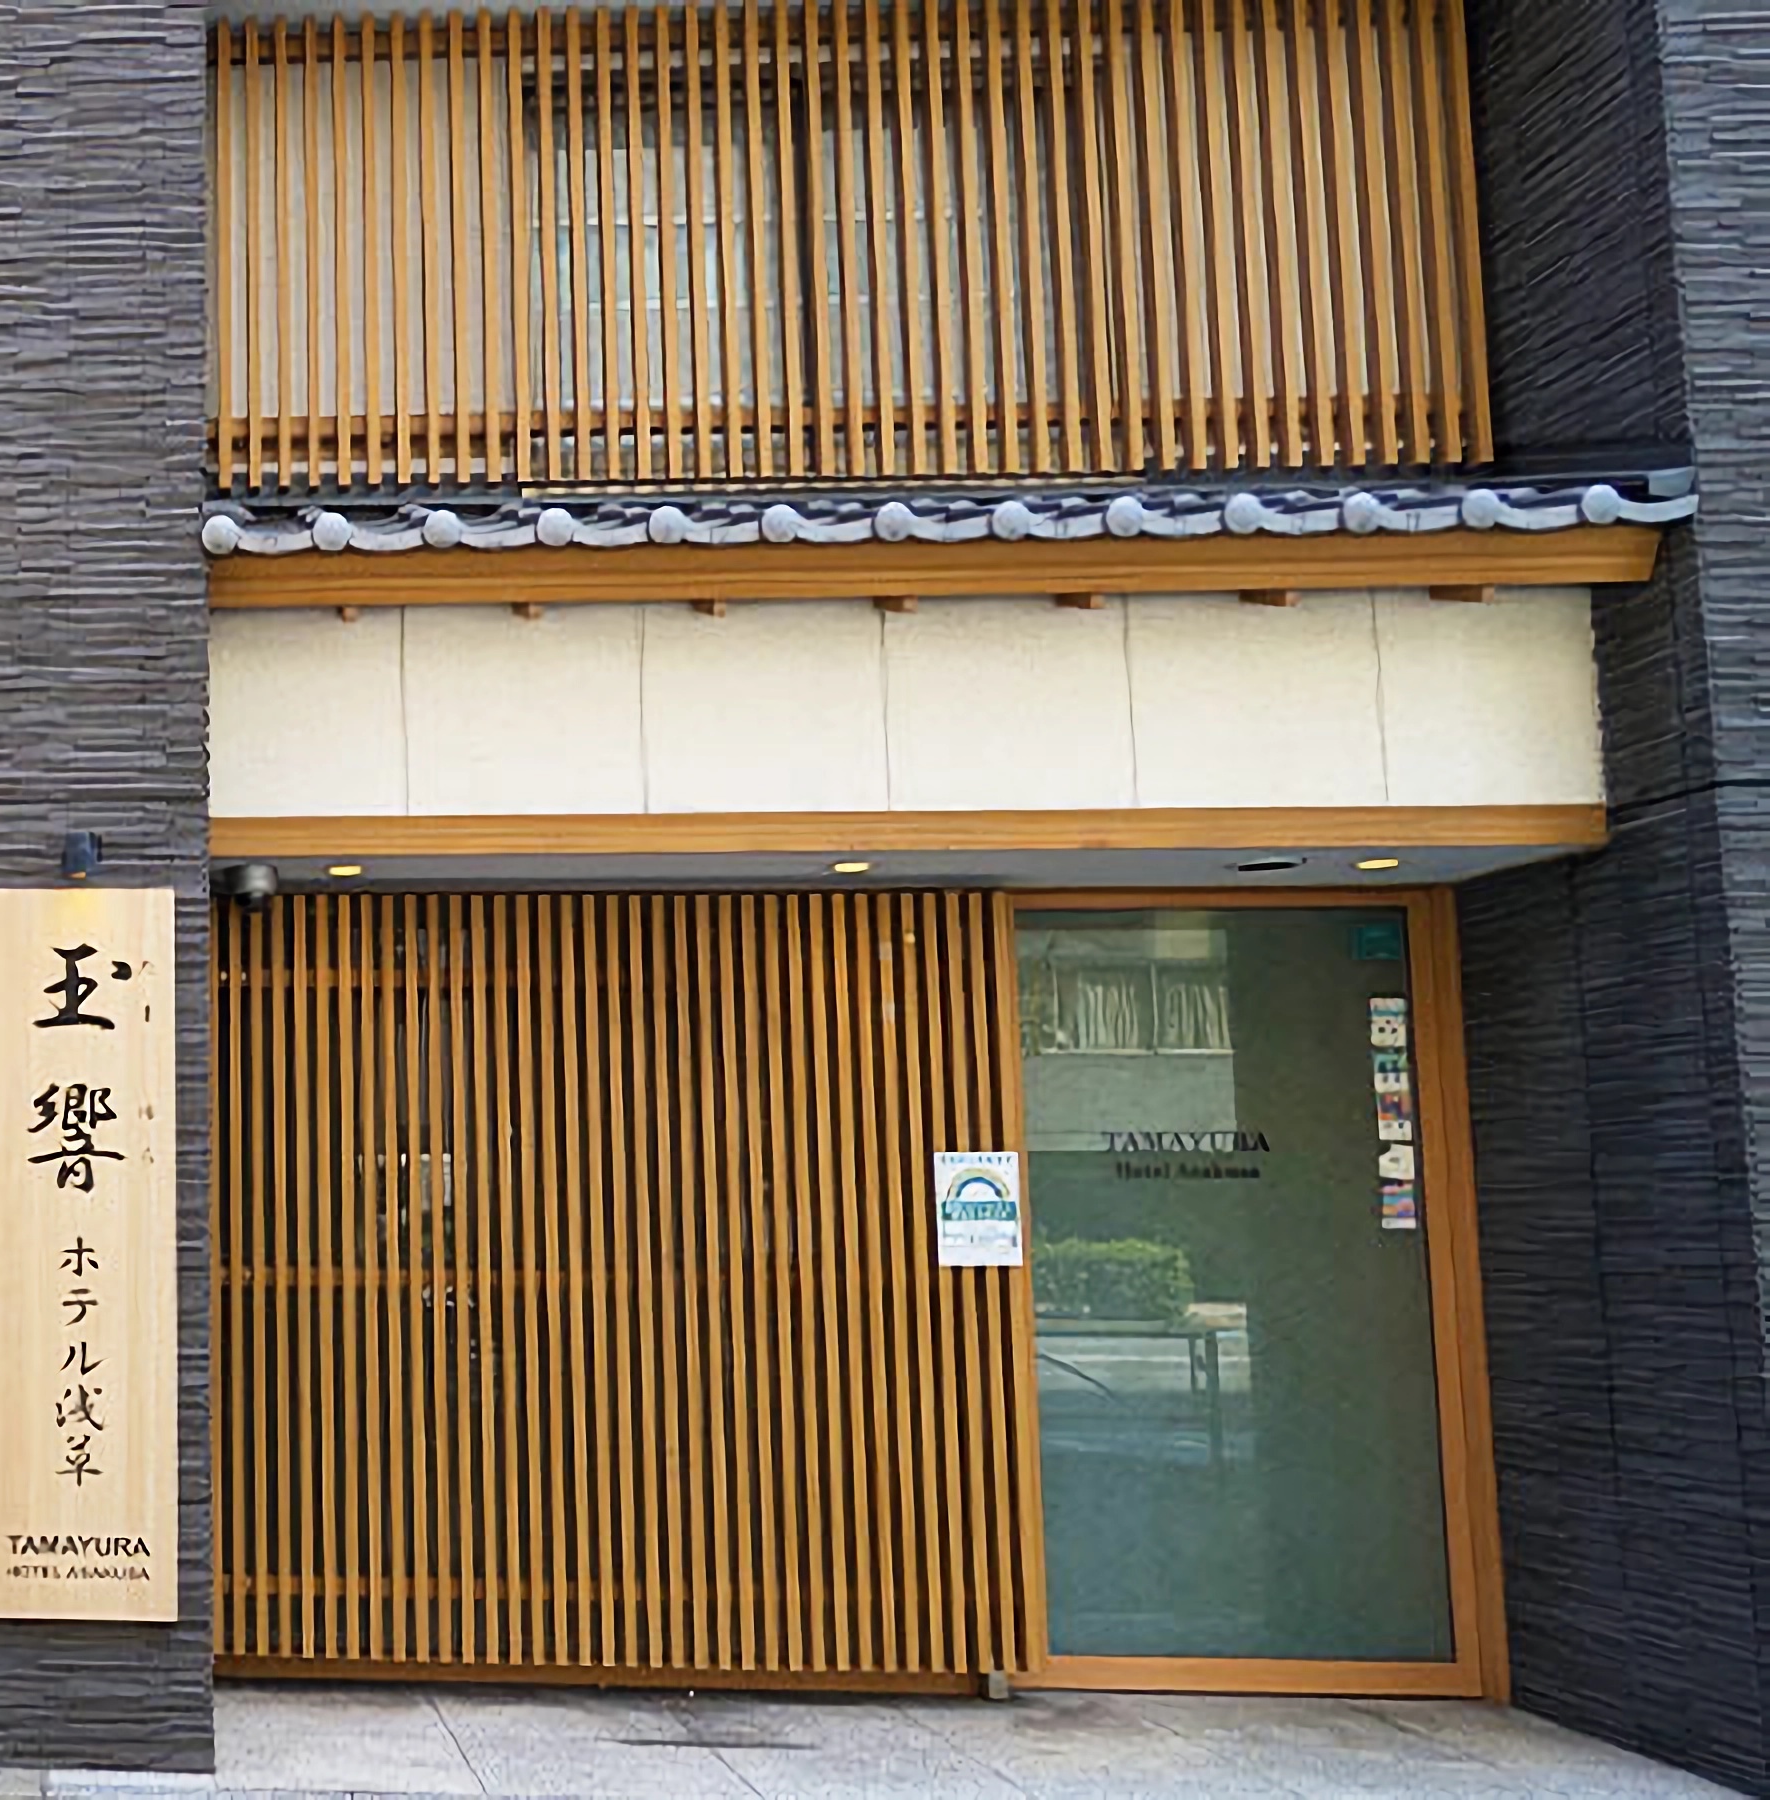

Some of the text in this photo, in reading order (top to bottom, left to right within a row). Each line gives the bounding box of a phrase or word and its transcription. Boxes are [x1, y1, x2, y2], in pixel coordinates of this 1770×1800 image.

[27, 943, 133, 1487] 玉響 ホテル浅草
[6, 1534, 151, 1557] TAMAYURA
